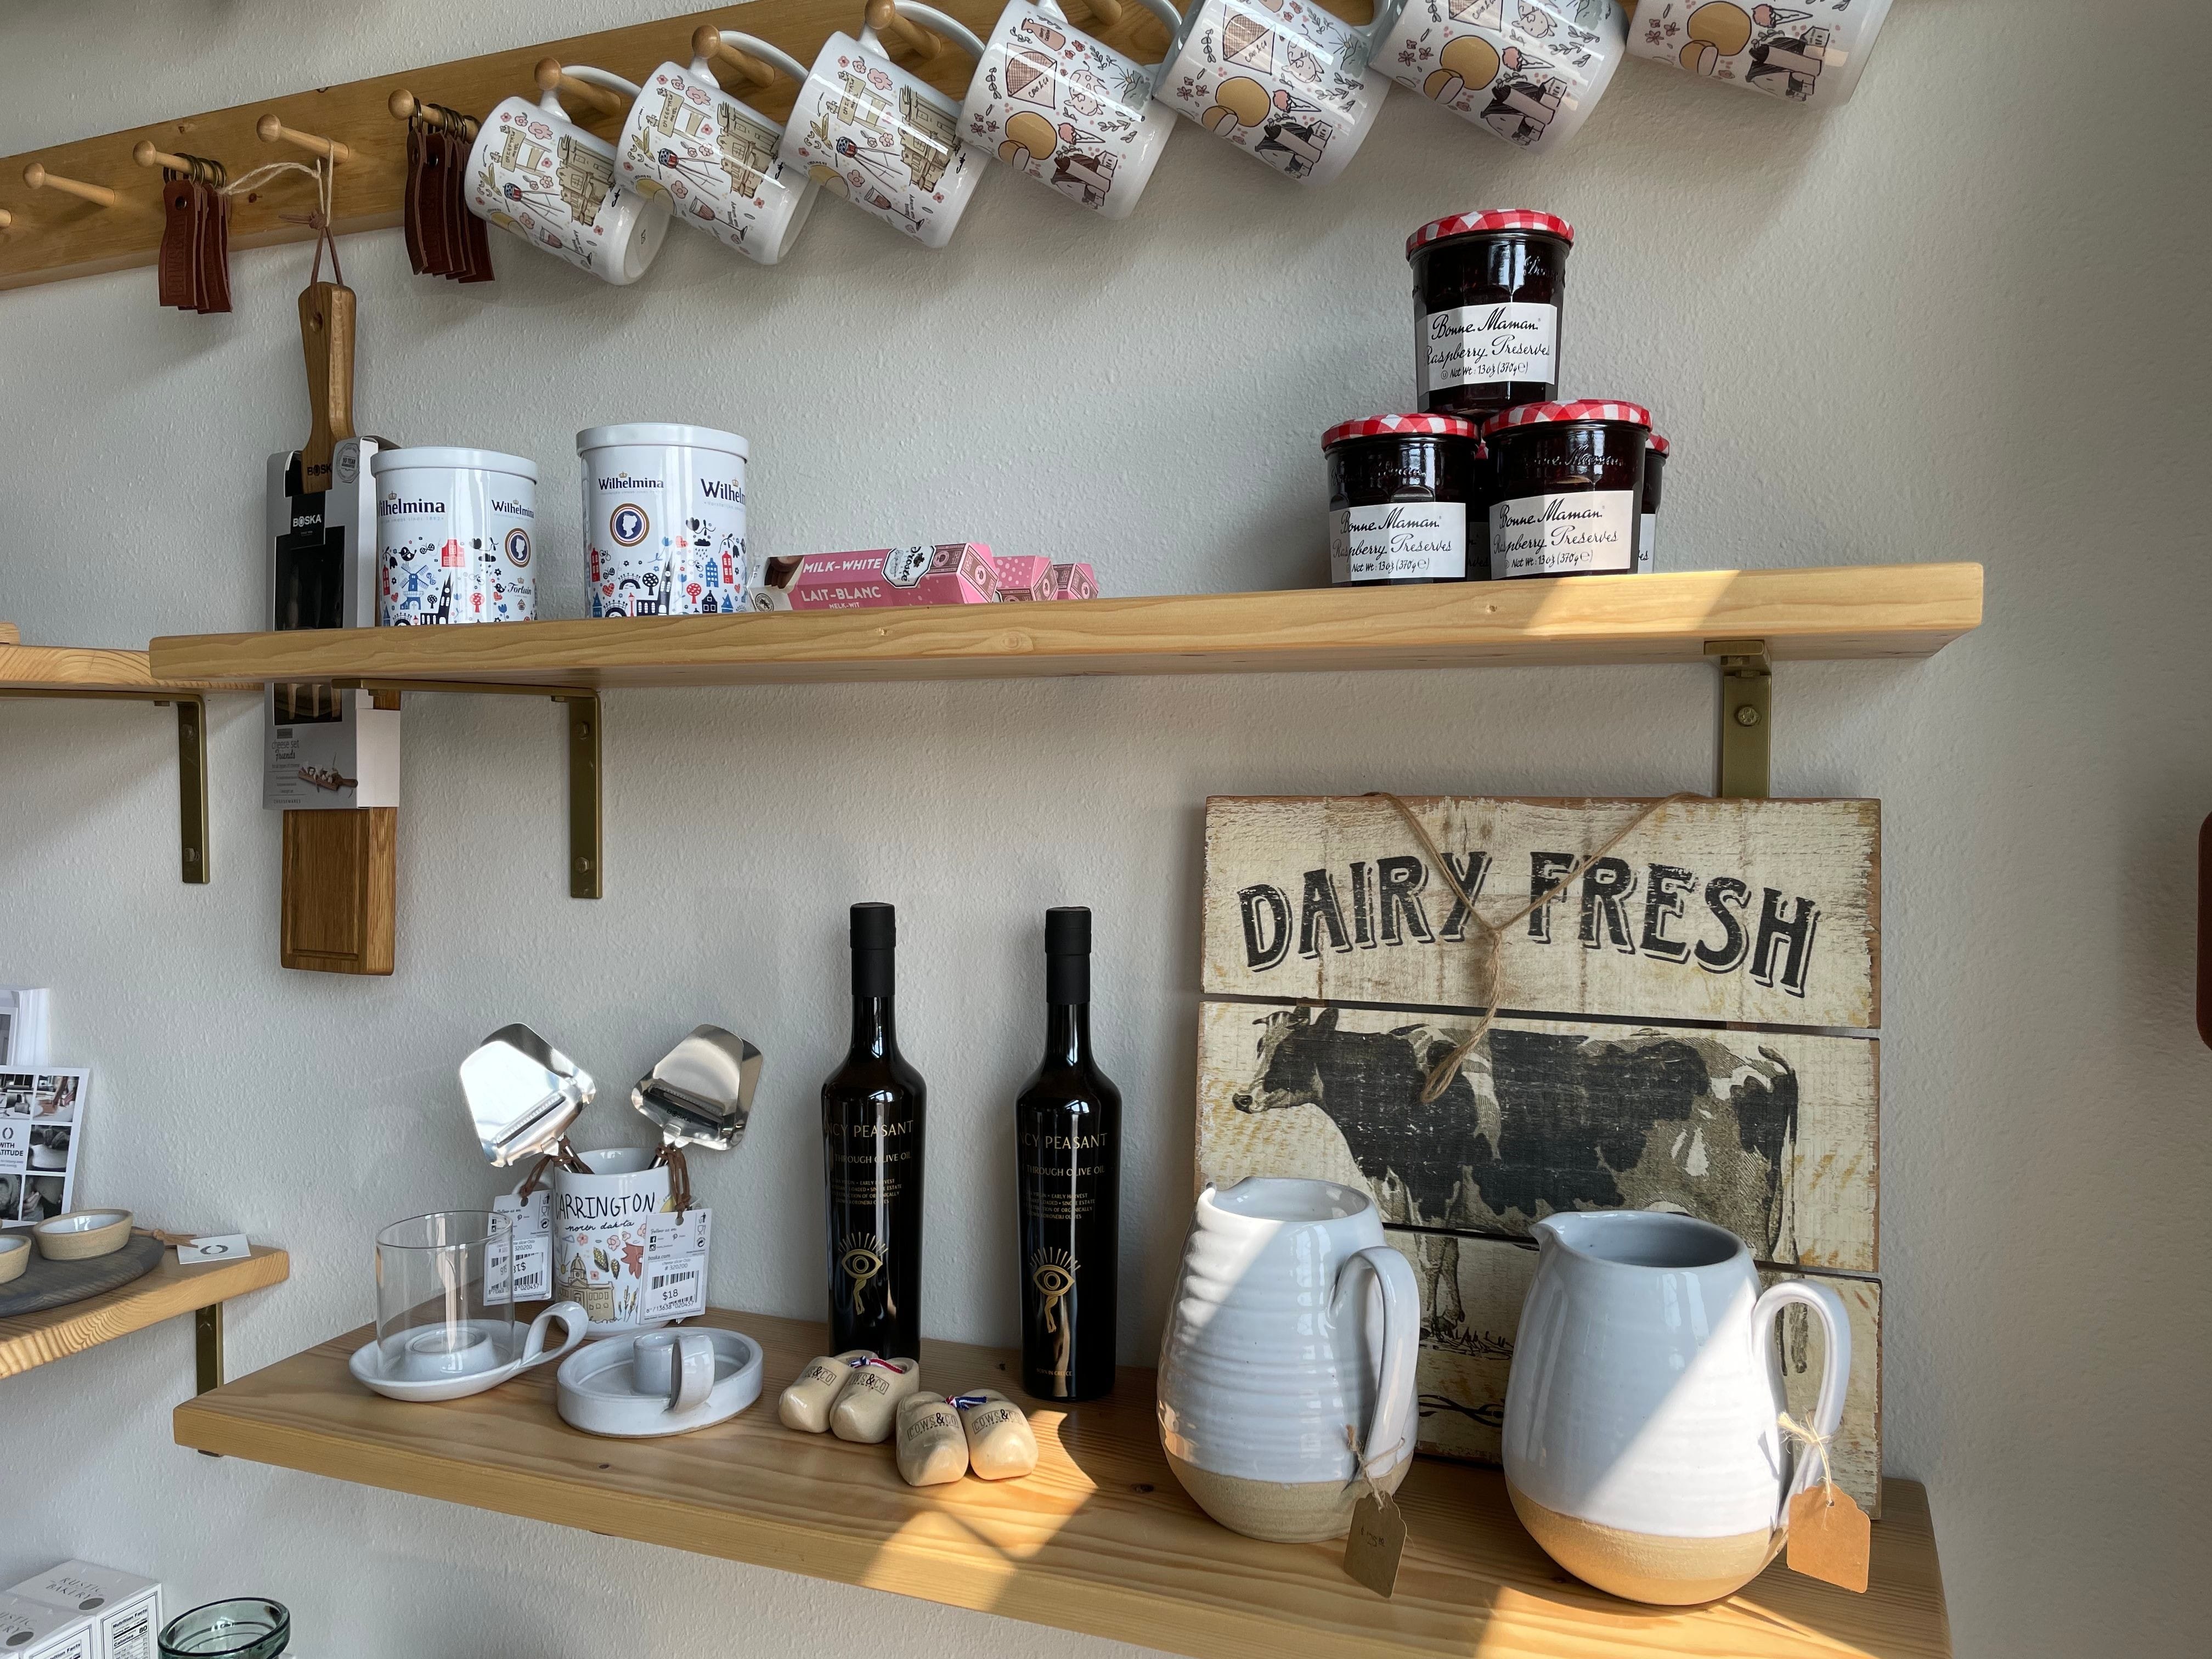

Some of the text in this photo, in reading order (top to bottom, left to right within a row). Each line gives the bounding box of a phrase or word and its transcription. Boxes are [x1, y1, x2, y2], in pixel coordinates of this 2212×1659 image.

[1431, 306, 1538, 340] Bonne Maman
[1425, 334, 1550, 369] Raspberry Preserves
[1449, 367, 1461, 379] Net
[598, 477, 664, 491] Wilhelmina
[292, 514, 321, 528] BOSKA
[1340, 506, 1440, 534] Bonne Maman
[1499, 497, 1602, 529] Bonne Maman
[1333, 533, 1452, 563] Raspberry Preserves
[1493, 525, 1619, 558] Raspberry Preserves
[803, 557, 883, 573] MILK-WHITE
[1351, 563, 1364, 572] Net
[1511, 557, 1524, 568] Net
[507, 583, 532, 596] Fortuin
[800, 586, 882, 602] LAIT-BLANC
[829, 601, 860, 610] MELK-WIT
[272, 740, 289, 749] cheese
[1237, 851, 1819, 998] DAIRY FRESH
[854, 1120, 914, 1138] PEASANT
[1046, 1133, 1108, 1149] PEASANT
[834, 1154, 872, 1164] THROUGH
[901, 1152, 912, 1160] OIL
[1026, 1165, 1064, 1176] THROUGH
[1094, 1165, 1105, 1175] OIL
[555, 1192, 656, 1220] CARRINGTON
[600, 1220, 635, 1229] dakota
[662, 1289, 679, 1301] $18
[675, 1300, 695, 1309] 020457
[909, 1412, 958, 1437] COWS&CO
[973, 1409, 1022, 1431] COWS&CO
[113, 1609, 148, 1629] Nutrition Facts
[114, 1634, 134, 1646] Calories
[139, 1625, 148, 1634] 80
